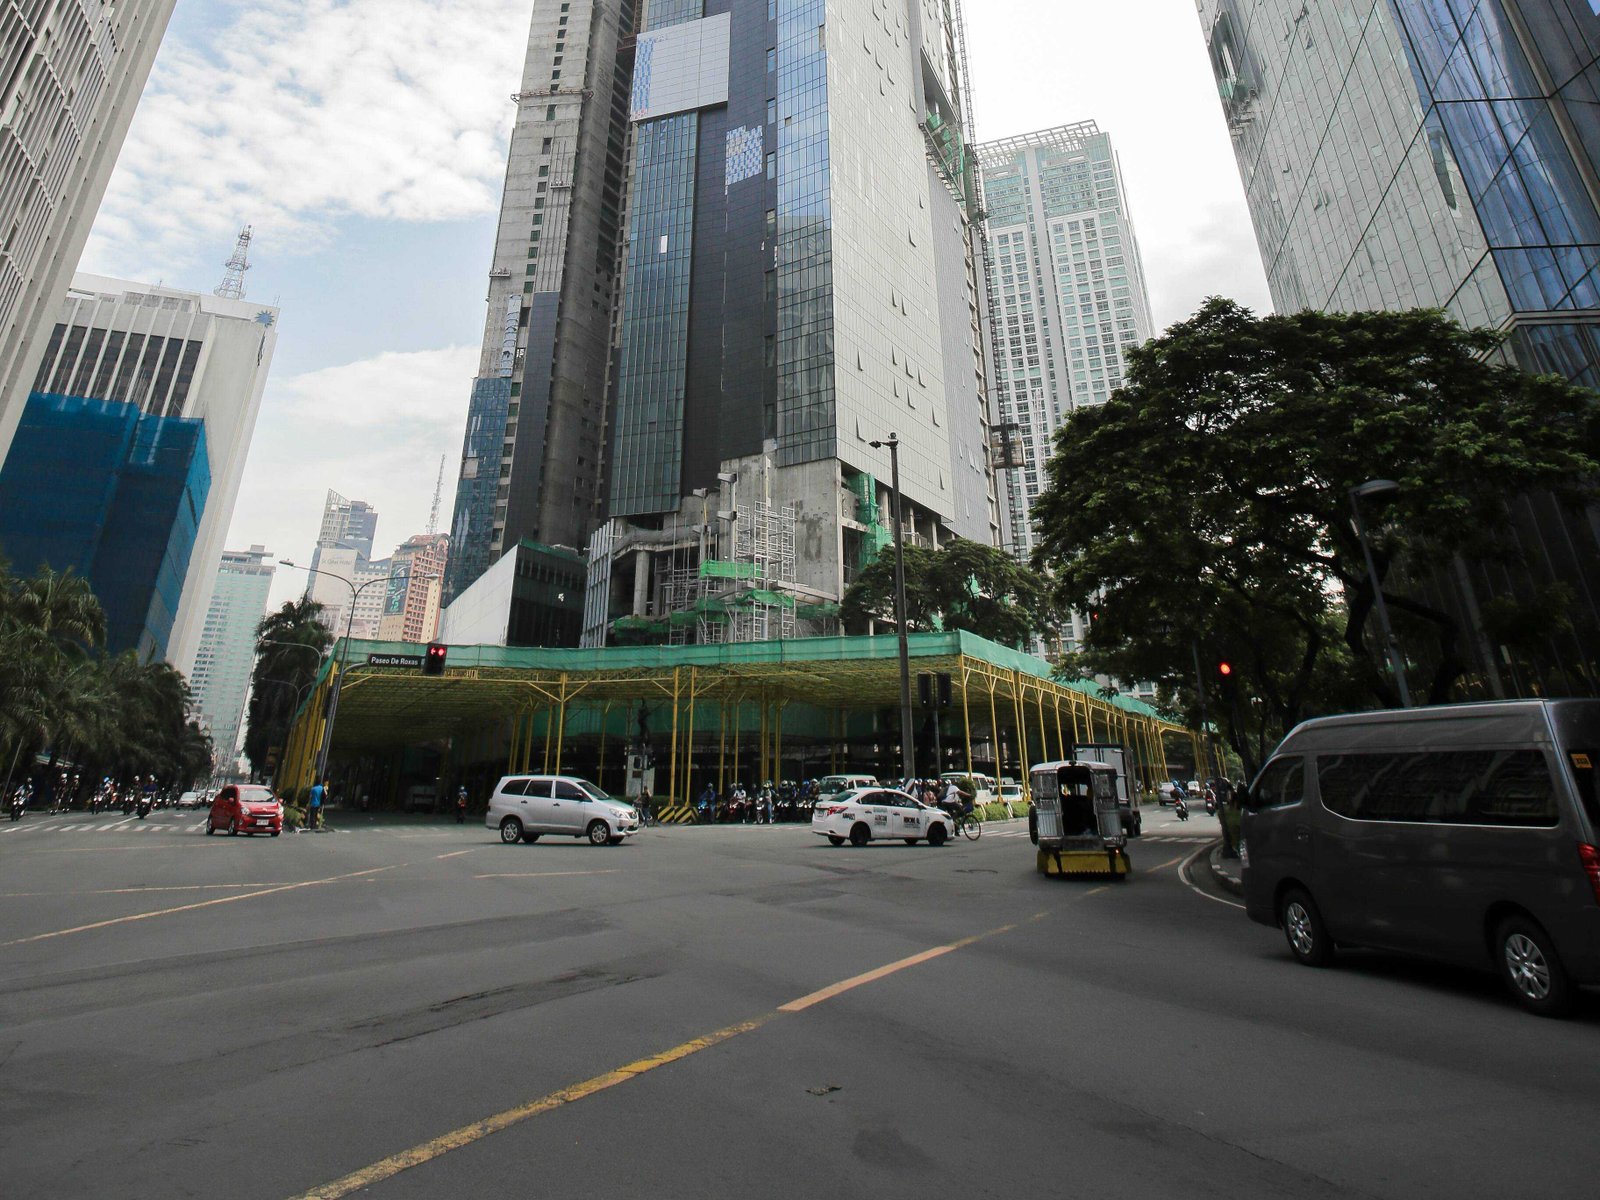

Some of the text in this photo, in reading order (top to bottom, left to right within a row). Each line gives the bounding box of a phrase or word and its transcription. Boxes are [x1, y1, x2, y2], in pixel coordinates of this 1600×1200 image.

[371, 656, 390, 665] Paseo
[391, 657, 399, 665] De
[400, 658, 418, 666] Roxas
